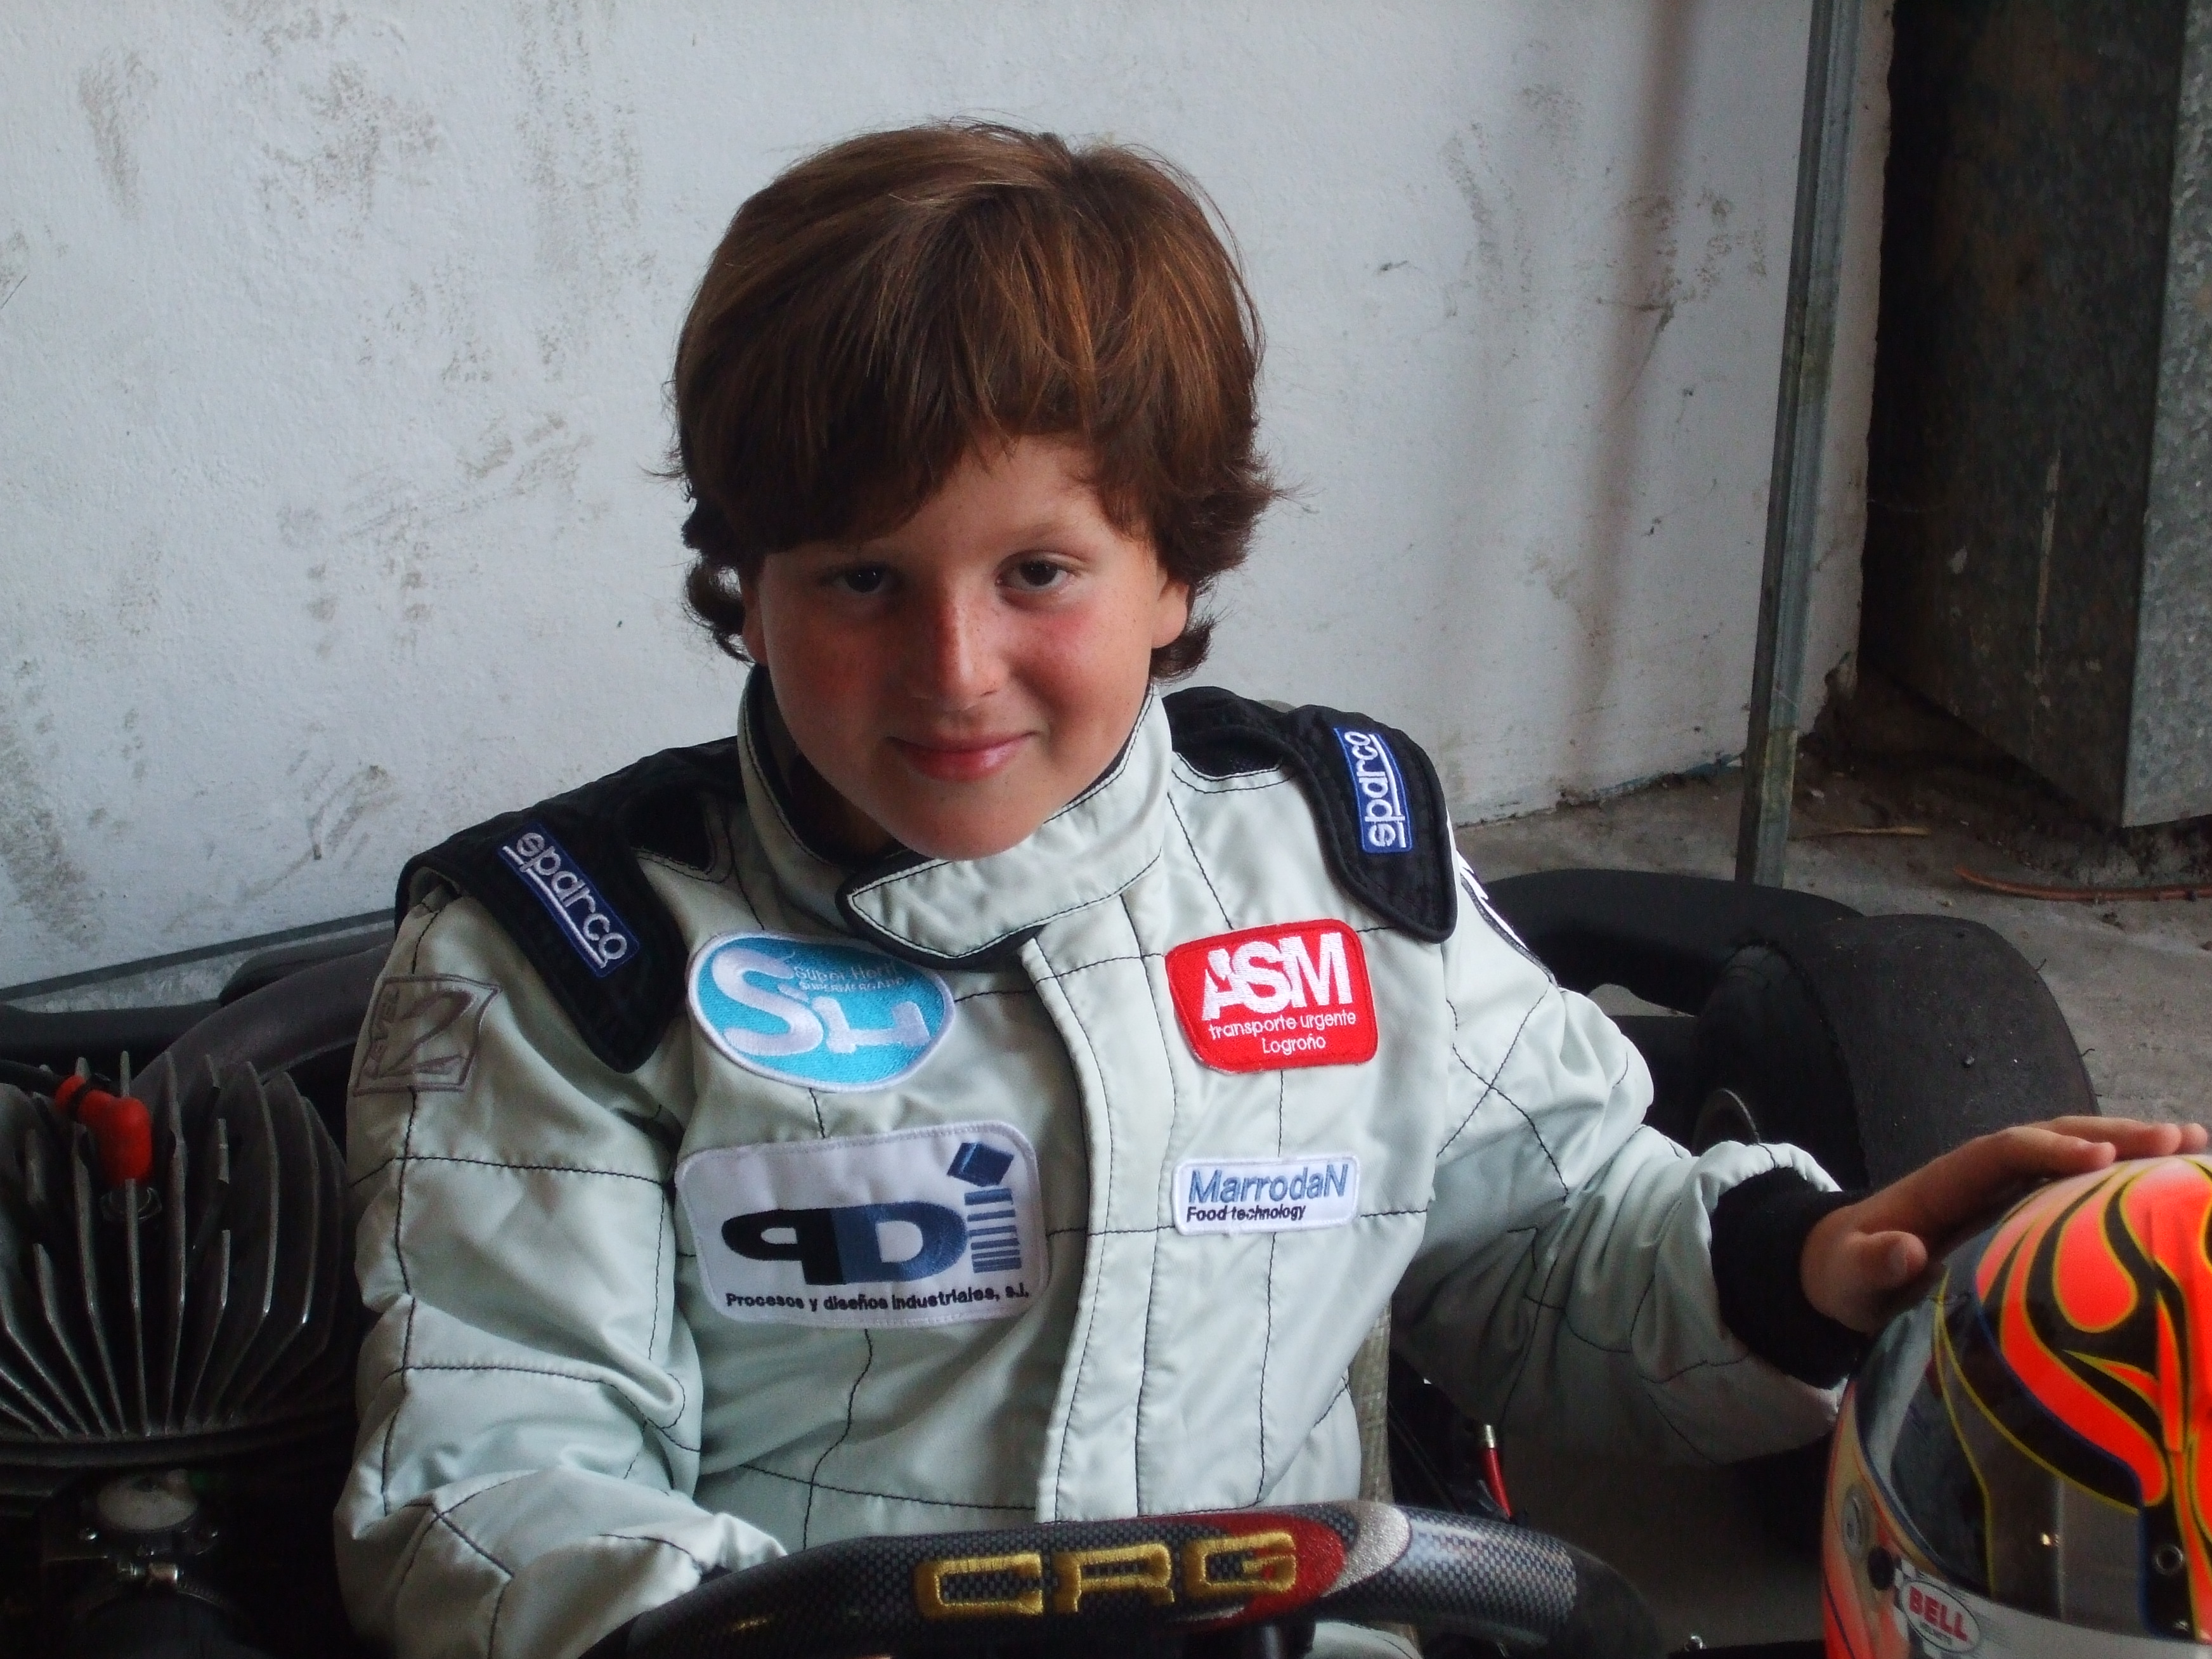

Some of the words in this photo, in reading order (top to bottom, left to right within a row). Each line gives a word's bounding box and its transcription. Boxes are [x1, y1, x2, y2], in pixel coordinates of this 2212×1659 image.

[1344, 731, 1405, 847] sparco
[515, 832, 627, 964] sparco
[1202, 932, 1353, 1020] ASM
[1208, 1014, 1298, 1041] transporte
[1299, 1009, 1356, 1031] urgente
[1261, 1033, 1327, 1056] Logroño
[1188, 1164, 1348, 1204] MarrodaN
[1187, 1204, 1228, 1223] Food
[1231, 1204, 1306, 1221] technology
[725, 1292, 804, 1310] Procesos
[809, 1298, 817, 1312] y
[824, 1293, 888, 1310] diseños
[914, 1530, 1297, 1620] CRG
[1908, 1585, 1968, 1643] BELL
